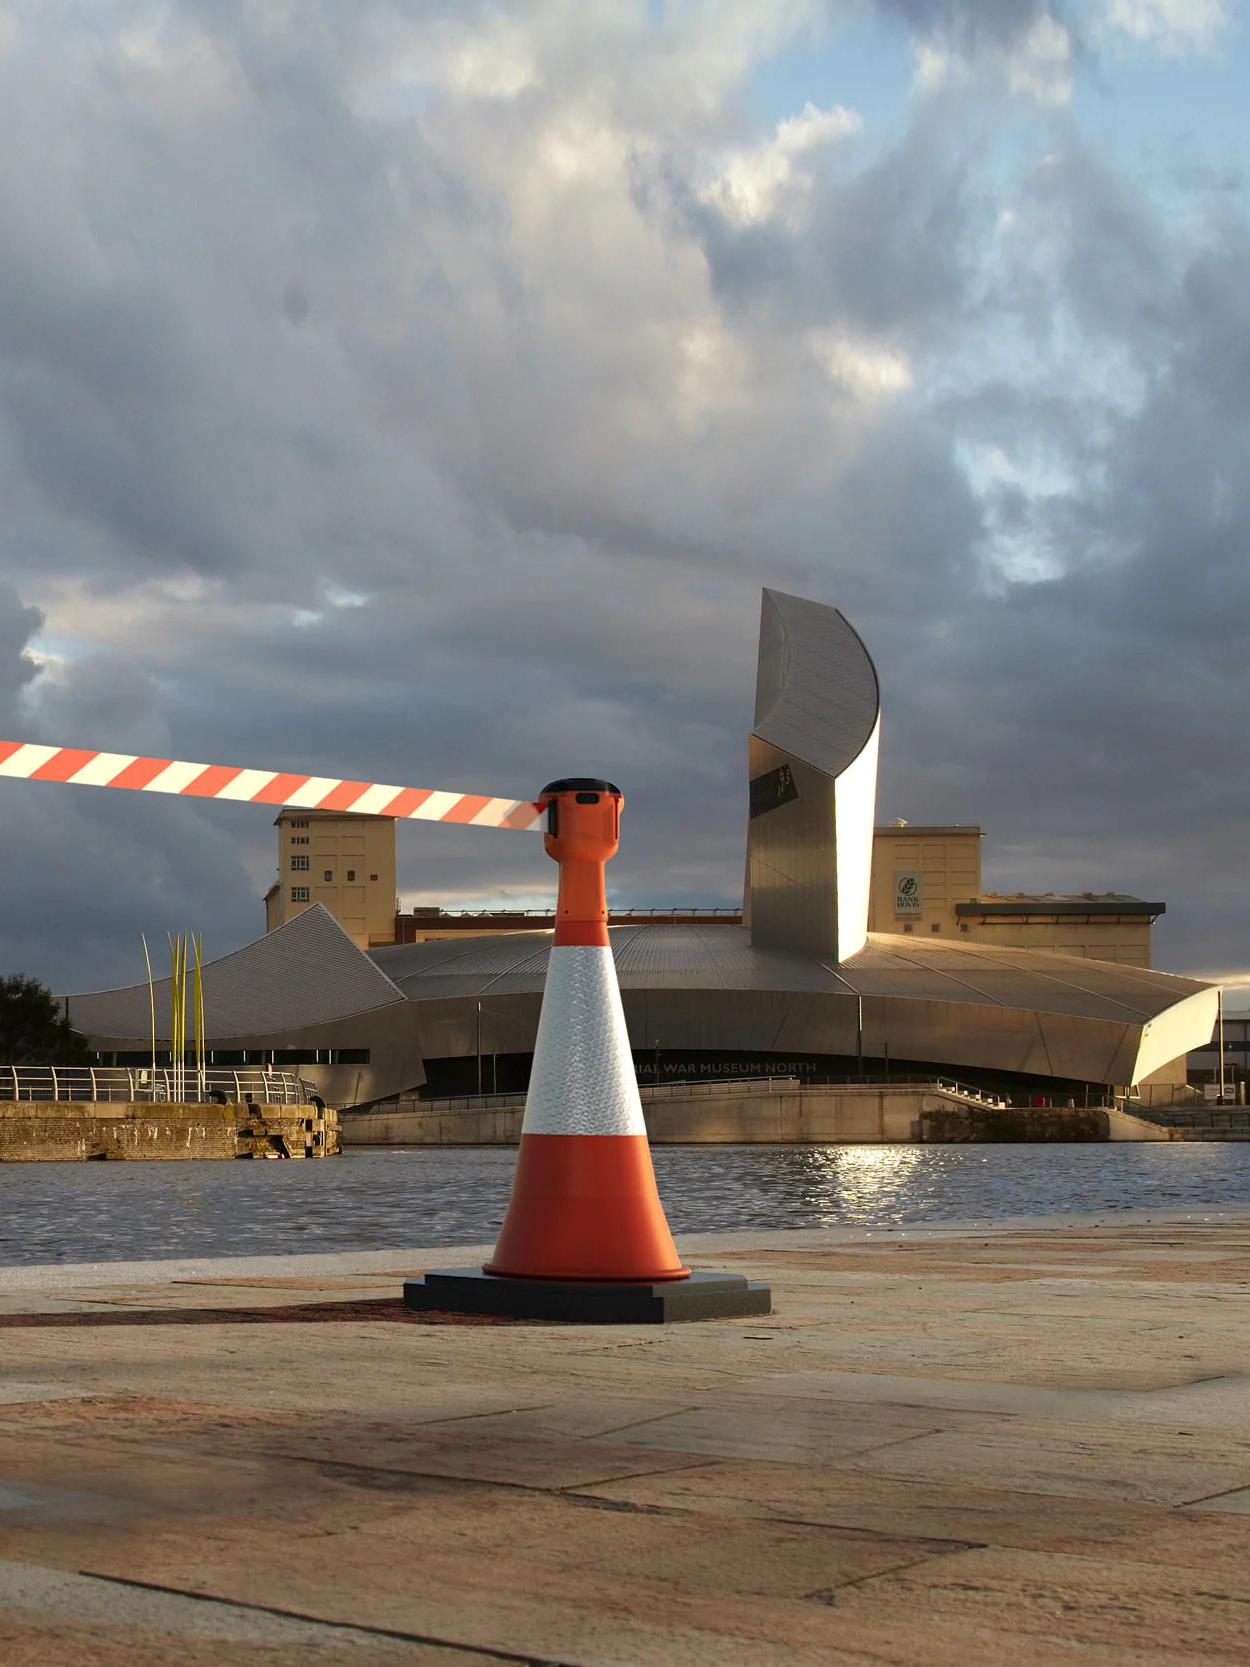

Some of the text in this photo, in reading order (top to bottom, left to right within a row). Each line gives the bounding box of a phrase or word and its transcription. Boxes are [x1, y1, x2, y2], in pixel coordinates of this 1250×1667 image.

[663, 1064, 696, 1074] WAR
[700, 1063, 761, 1073] MUSEUM
[765, 1063, 816, 1073] NORTH
